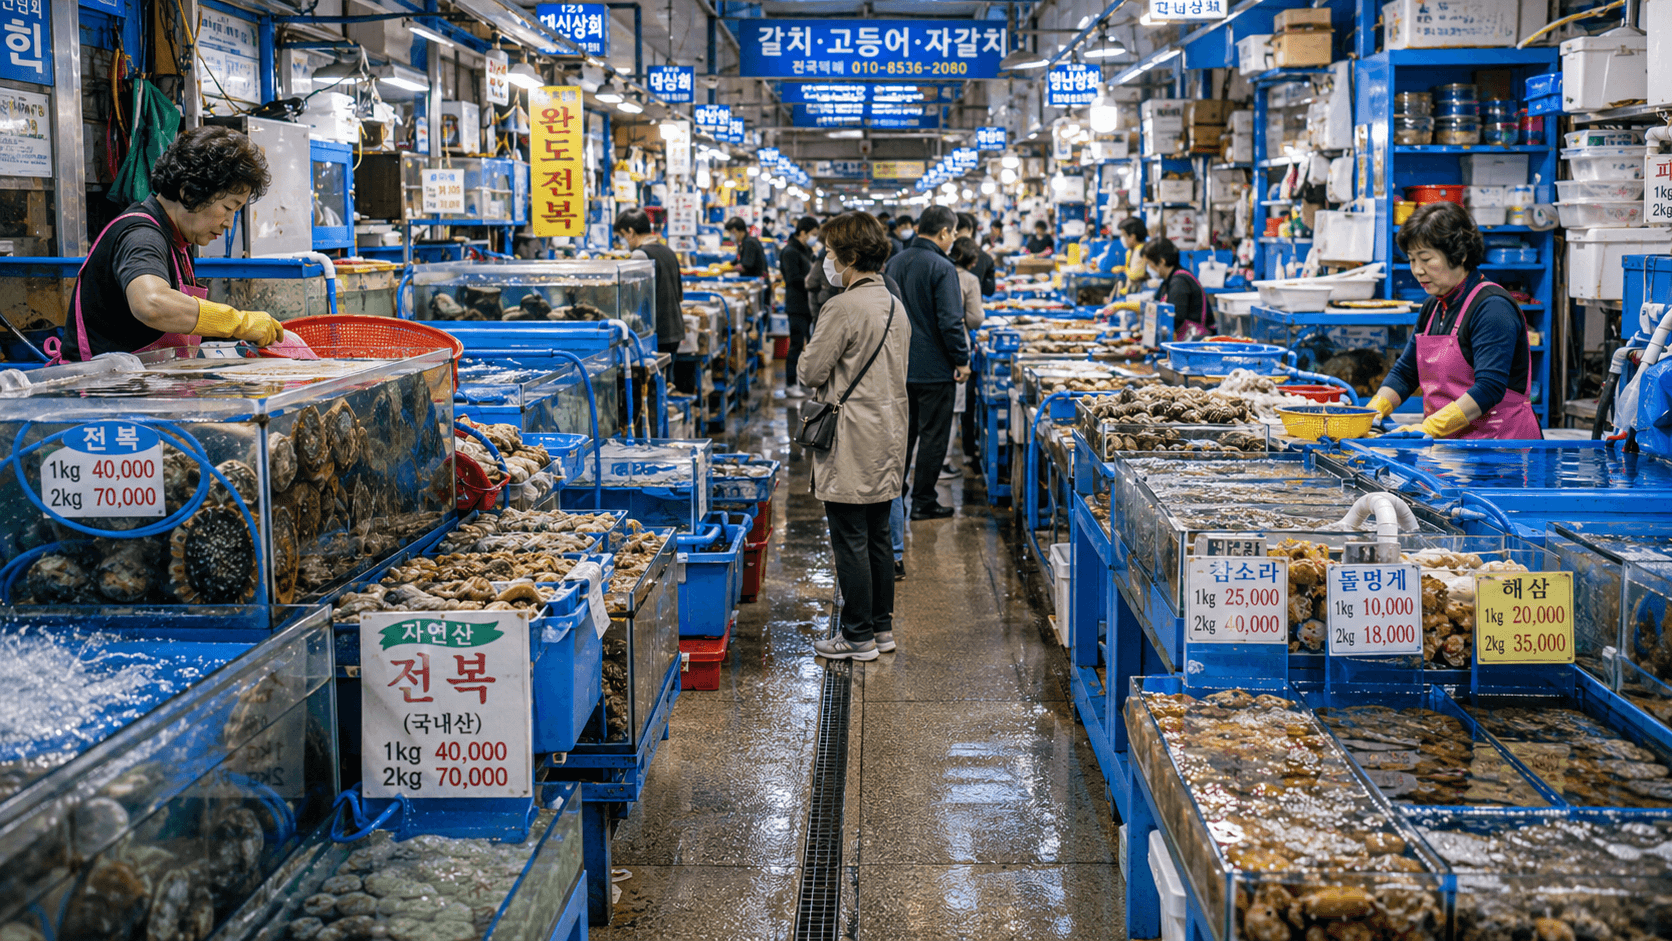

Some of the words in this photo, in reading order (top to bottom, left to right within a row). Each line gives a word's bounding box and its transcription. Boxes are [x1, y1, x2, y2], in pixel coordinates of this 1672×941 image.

[852, 61, 968, 75] 010-8536-2080
[539, 105, 577, 229] 완도전복
[83, 426, 140, 452] 전복
[50, 460, 80, 482] 1kg
[92, 459, 155, 481] 40,000
[51, 488, 82, 510] 2kg
[94, 487, 156, 508] 70,000
[1210, 561, 1280, 583] 참소라
[1338, 569, 1406, 592] 돌멍게
[1195, 589, 1216, 608] 1kg
[1225, 588, 1279, 608] 25,000
[1502, 577, 1550, 599] 해삼
[1335, 600, 1353, 618] 1kg
[1363, 597, 1413, 618] 10,000
[1485, 608, 1503, 626] 1kg
[1513, 605, 1565, 626] 20,000
[402, 620, 474, 646] 자연산
[1194, 615, 1216, 634] 2kg
[1225, 615, 1279, 635] 40,000
[1336, 628, 1355, 646] 2kg
[1364, 624, 1415, 647] 18,000
[1485, 635, 1505, 654] 2kg
[1513, 633, 1565, 654] 35,000
[387, 652, 497, 705] 전복
[404, 712, 482, 735] (국내산)
[384, 741, 422, 765] 1kg
[435, 741, 508, 764] 40,000
[383, 767, 422, 790] 2kg
[435, 767, 508, 789] 70,000
